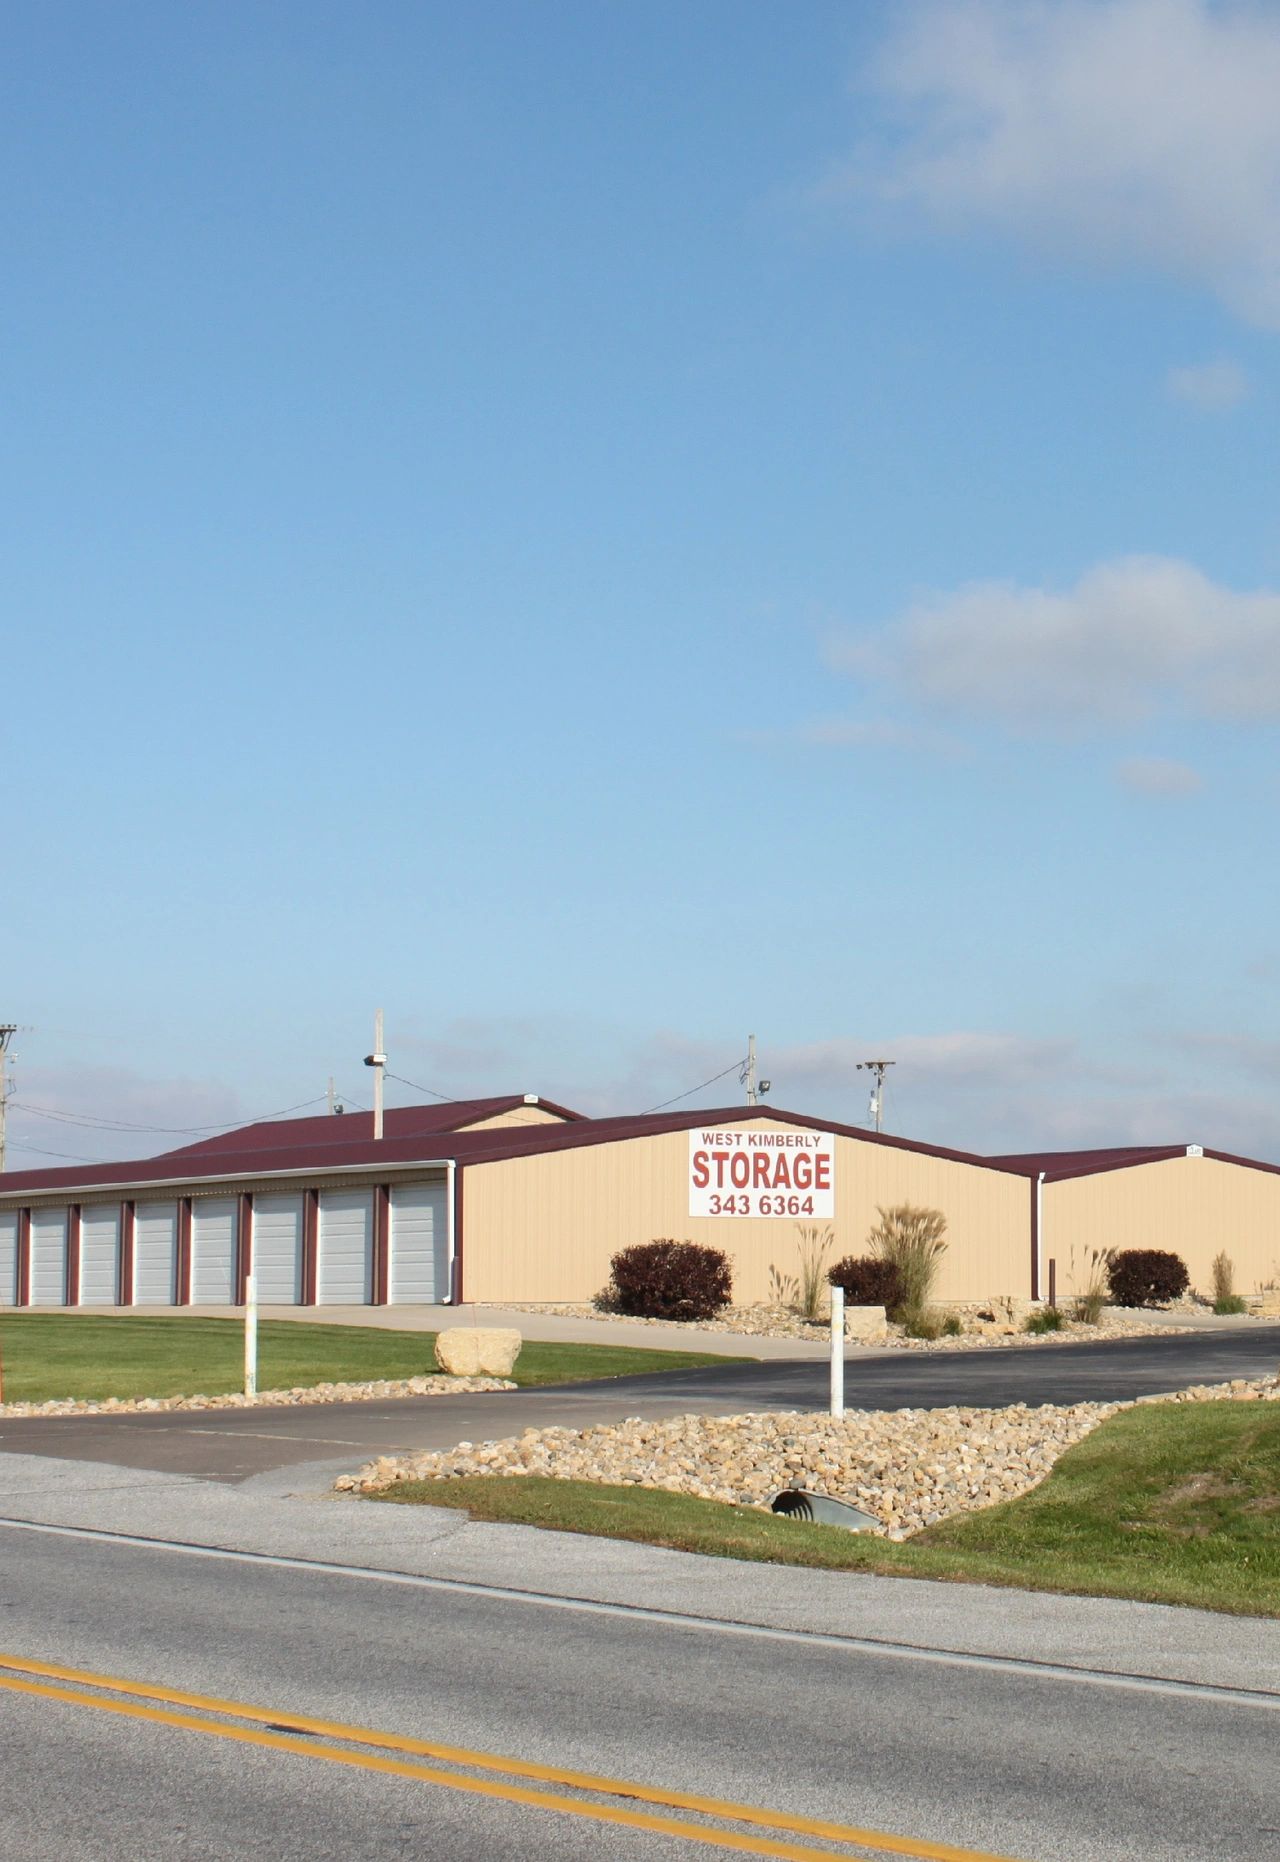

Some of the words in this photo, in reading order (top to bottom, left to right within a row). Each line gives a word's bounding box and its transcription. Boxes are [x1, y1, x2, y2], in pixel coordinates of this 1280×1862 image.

[702, 1133, 742, 1146] WEST
[748, 1134, 821, 1147] KIMBERLY
[692, 1151, 830, 1189] STORAGE
[709, 1194, 750, 1215] 343
[759, 1195, 814, 1215] 6364
